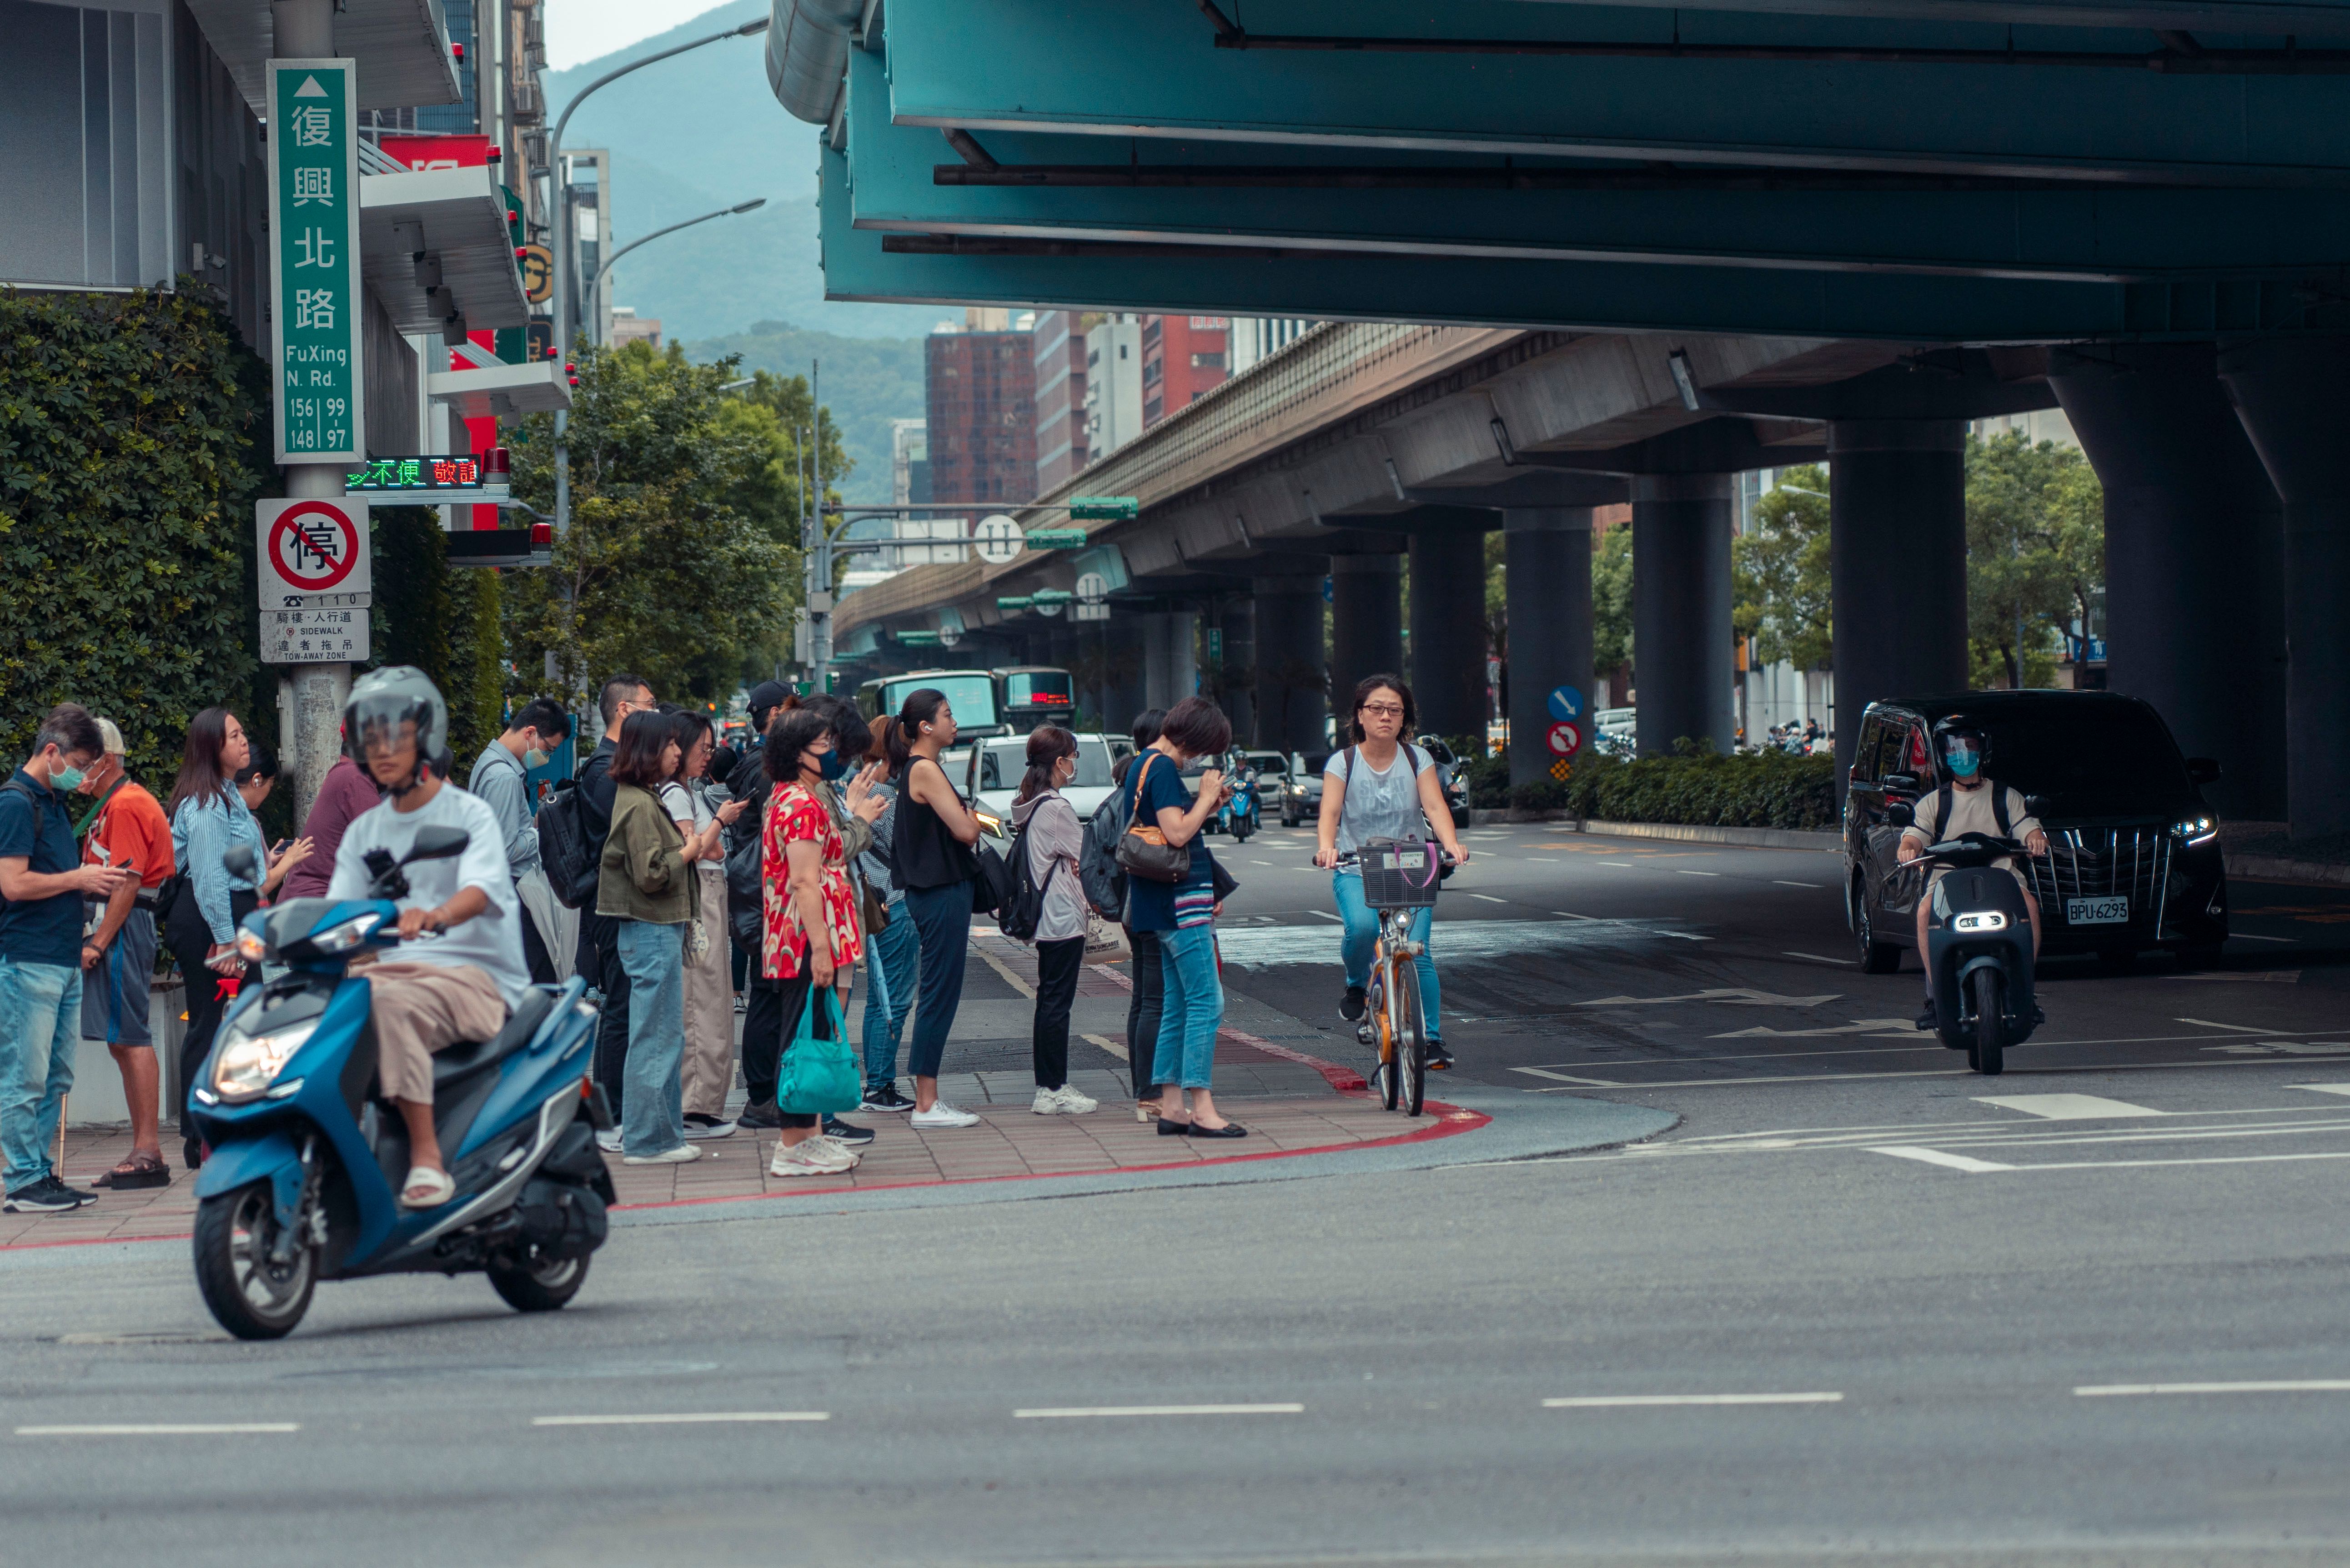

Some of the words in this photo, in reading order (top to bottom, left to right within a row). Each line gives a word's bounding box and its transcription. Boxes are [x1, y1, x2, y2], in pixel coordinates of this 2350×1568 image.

[291, 105, 336, 330] 復興北路
[286, 345, 346, 367] FuXing
[287, 370, 303, 387] N.
[311, 370, 336, 386] Rd.
[291, 398, 313, 417] 156
[326, 398, 345, 417] 99
[291, 430, 314, 448] 148
[327, 429, 346, 448] 97
[289, 522, 338, 570] 停
[278, 639, 352, 651] 違者拖吊
